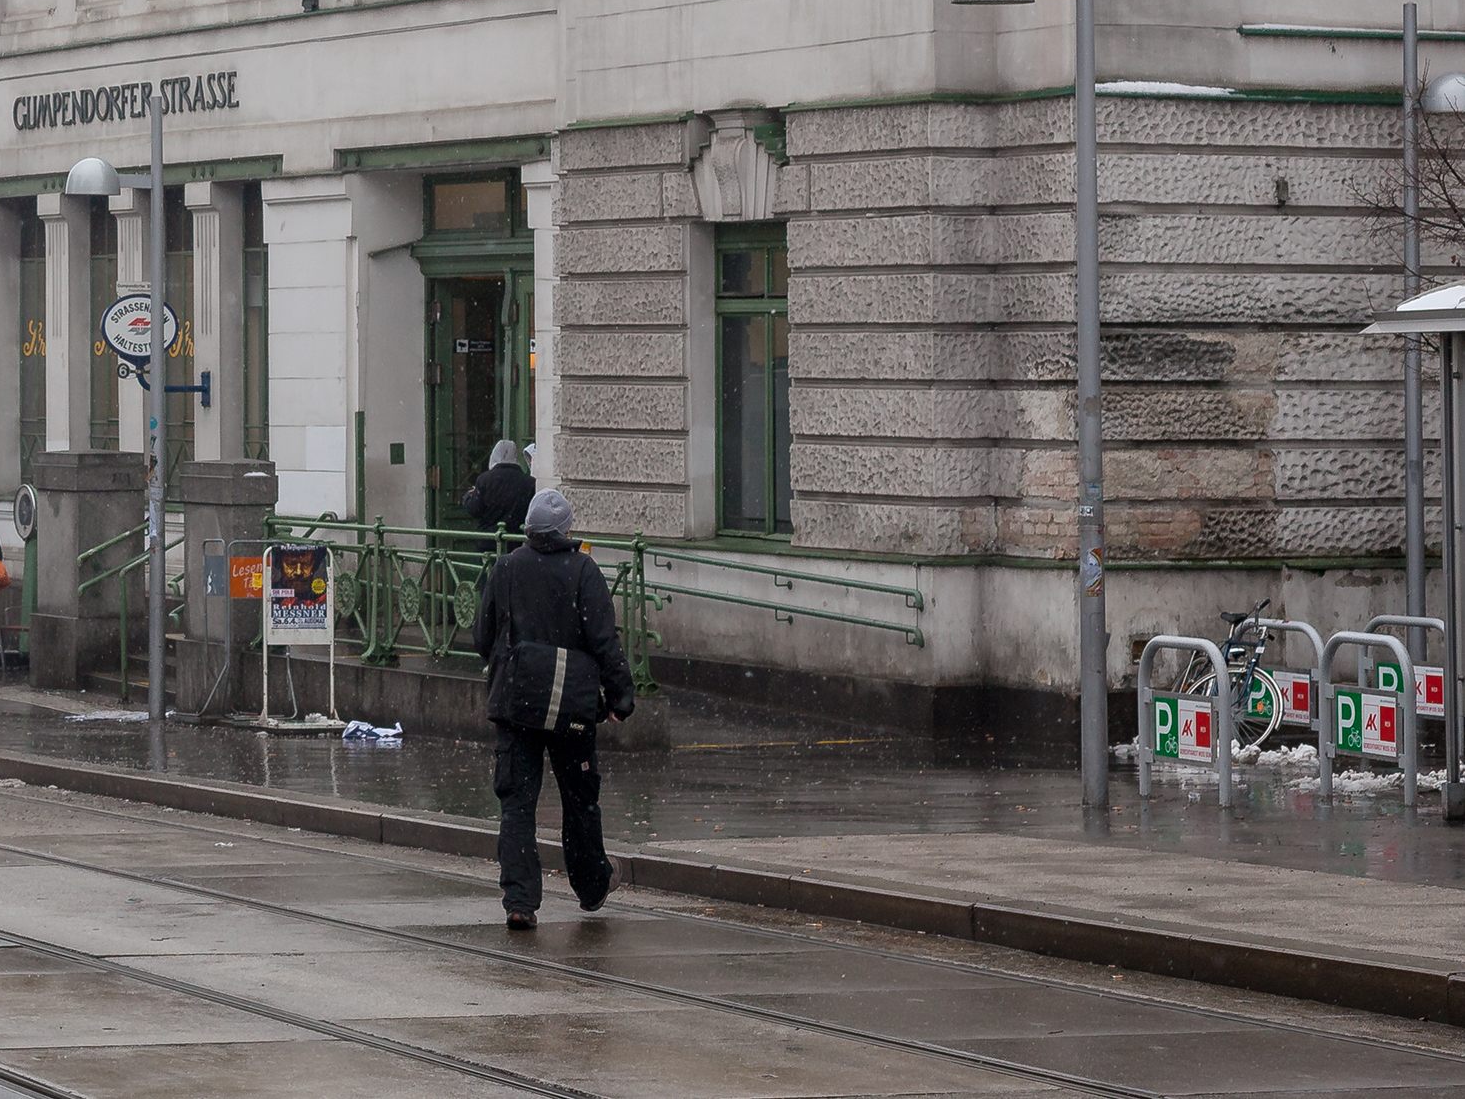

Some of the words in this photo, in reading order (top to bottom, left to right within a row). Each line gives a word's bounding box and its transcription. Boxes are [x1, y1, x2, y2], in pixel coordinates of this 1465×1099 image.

[12, 81, 153, 131] GUMPENDORFER
[159, 70, 240, 115] STRASSE
[110, 301, 170, 326] STRASSENN
[113, 334, 168, 353] HALTEST
[119, 364, 128, 375] 6
[273, 609, 326, 618] MESSNER
[1155, 701, 1173, 751] P
[1181, 719, 1193, 737] AK
[1338, 695, 1356, 745] P
[1365, 713, 1378, 731] AK
